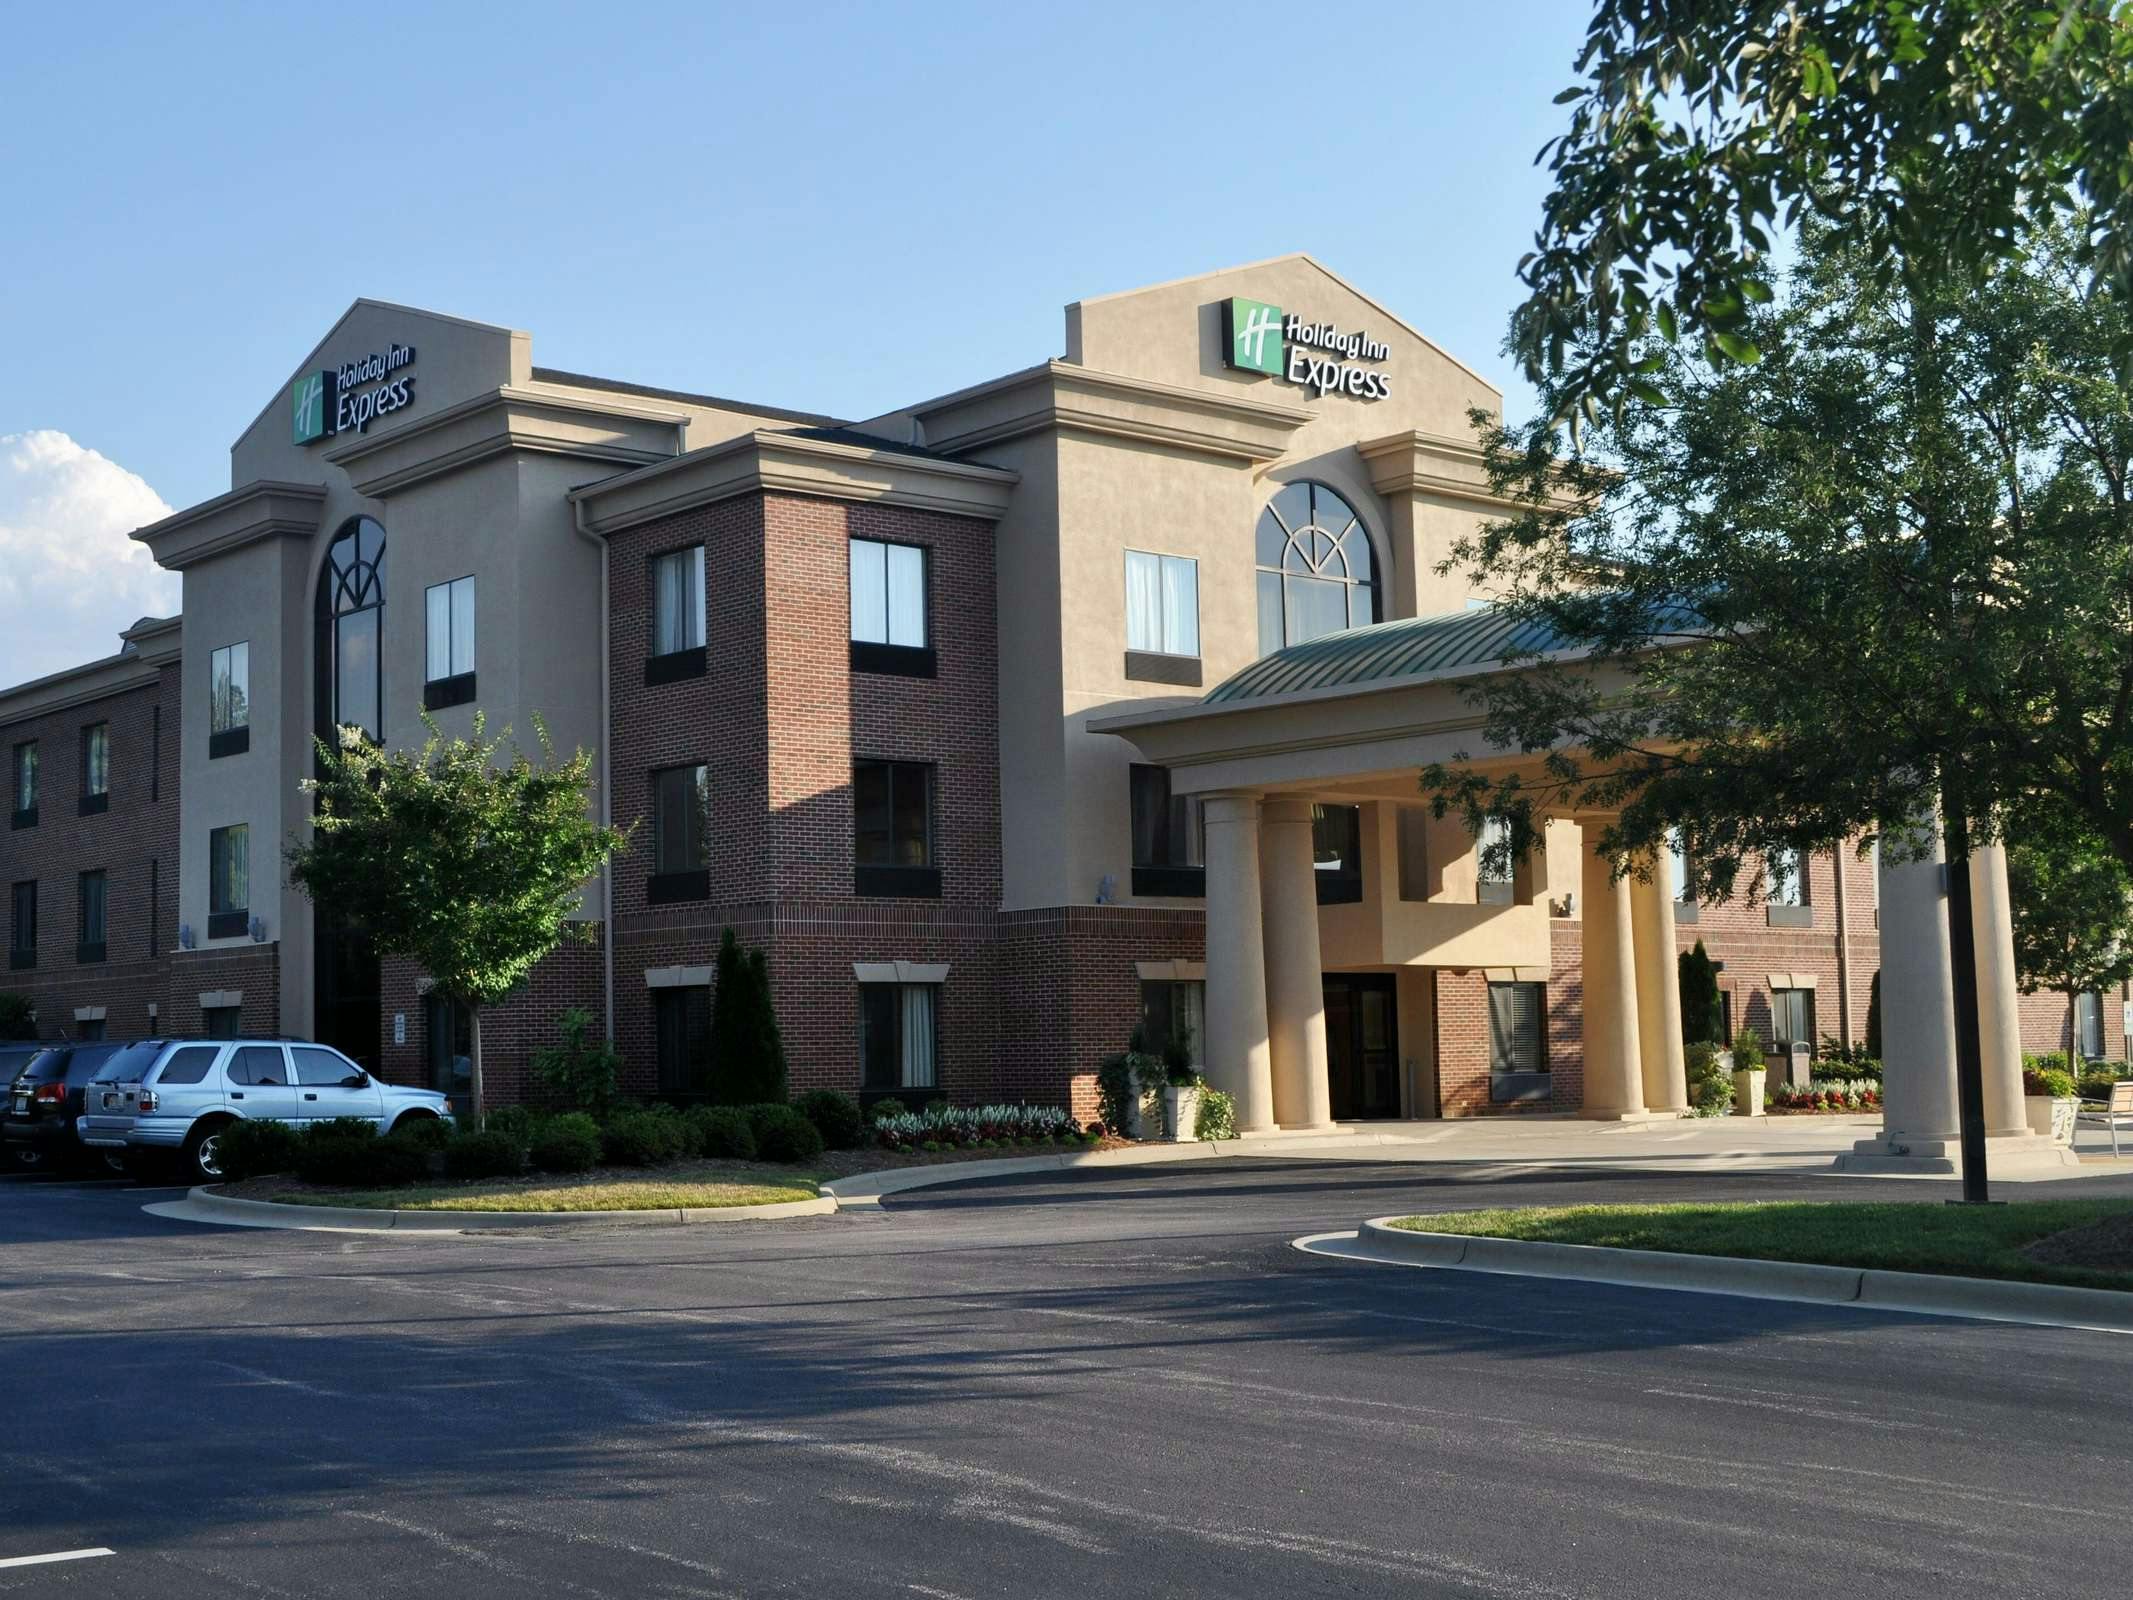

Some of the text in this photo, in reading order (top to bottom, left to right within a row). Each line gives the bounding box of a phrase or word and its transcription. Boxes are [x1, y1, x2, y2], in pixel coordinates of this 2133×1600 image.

[1286, 312, 1391, 361] Holiday Inn
[337, 343, 410, 392] Holiday Inn
[1287, 345, 1392, 400] Express
[336, 376, 410, 433] Express
